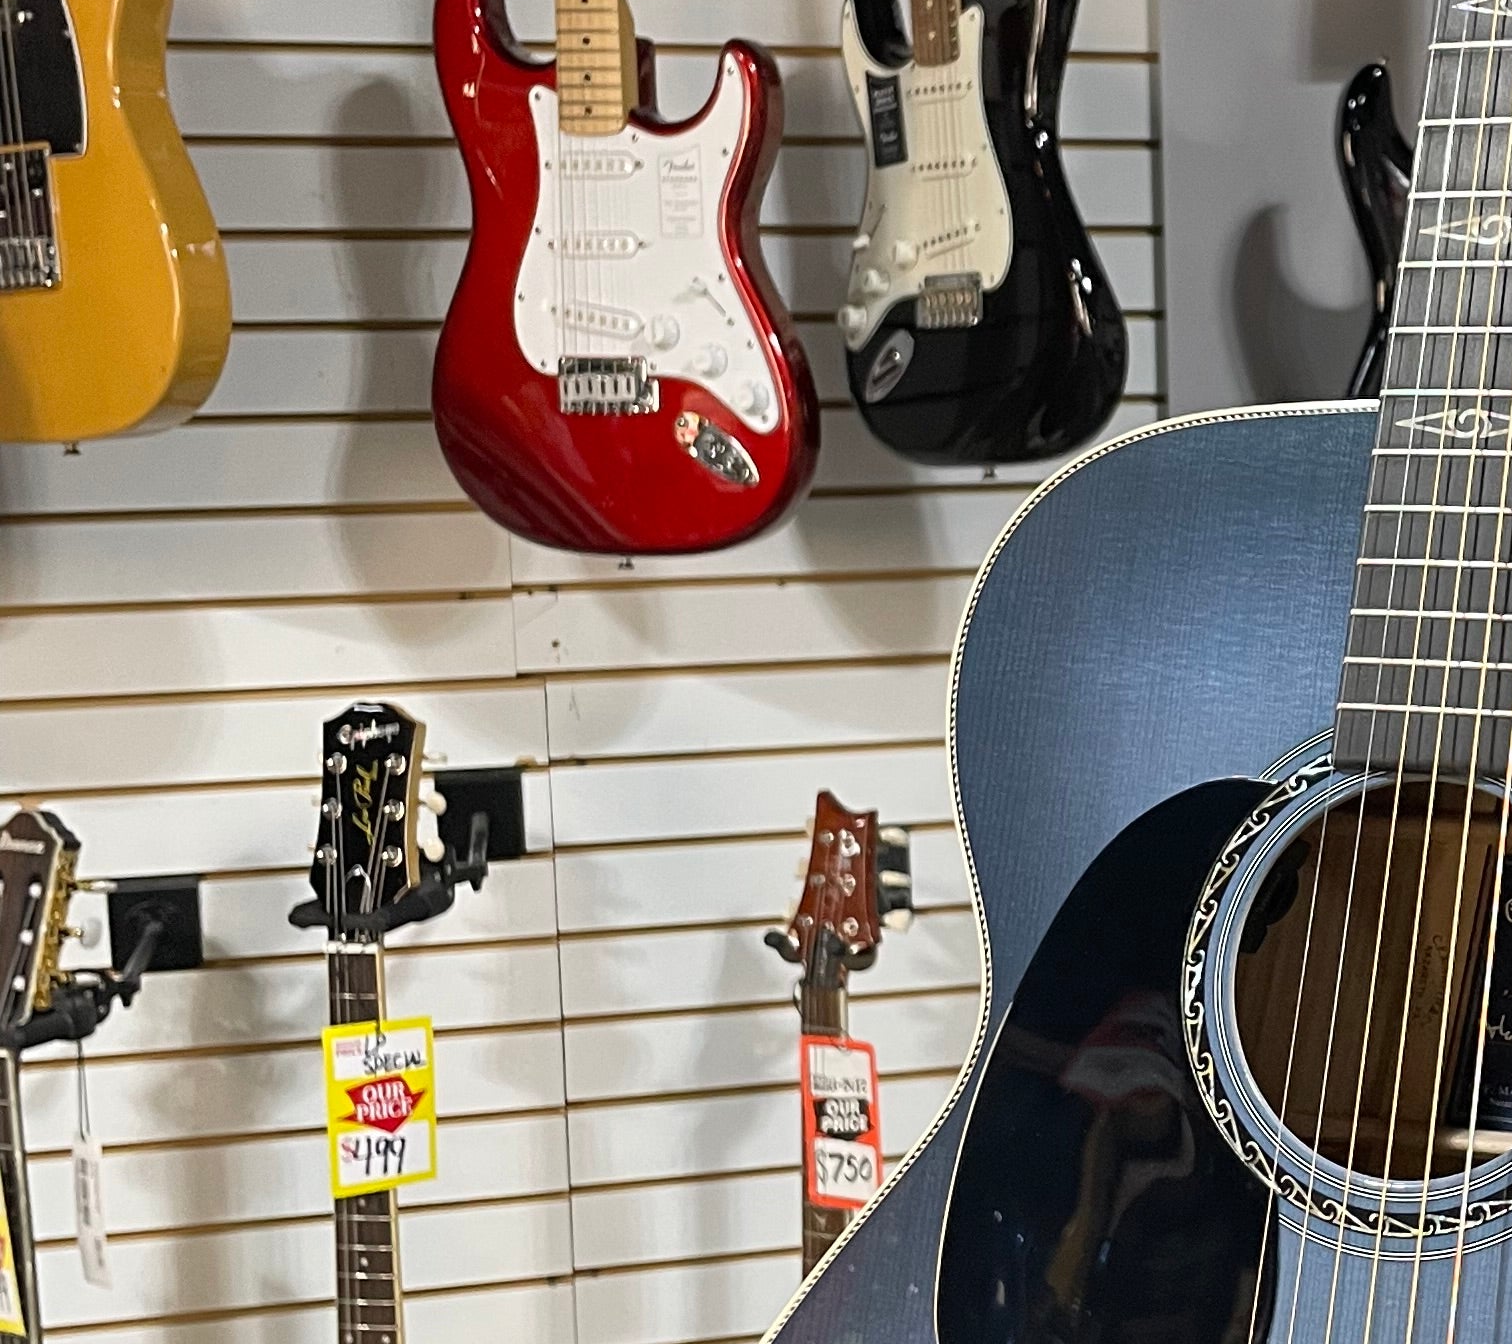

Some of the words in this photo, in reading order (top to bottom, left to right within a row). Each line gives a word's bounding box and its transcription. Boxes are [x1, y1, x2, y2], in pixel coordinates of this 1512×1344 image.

[362, 1080, 406, 1103] OUR
[355, 1095, 414, 1123] PRICE
[825, 1098, 861, 1116] OUR
[820, 1113, 869, 1133] PRICE
[342, 1135, 406, 1177] $499
[816, 1149, 873, 1189] $750
